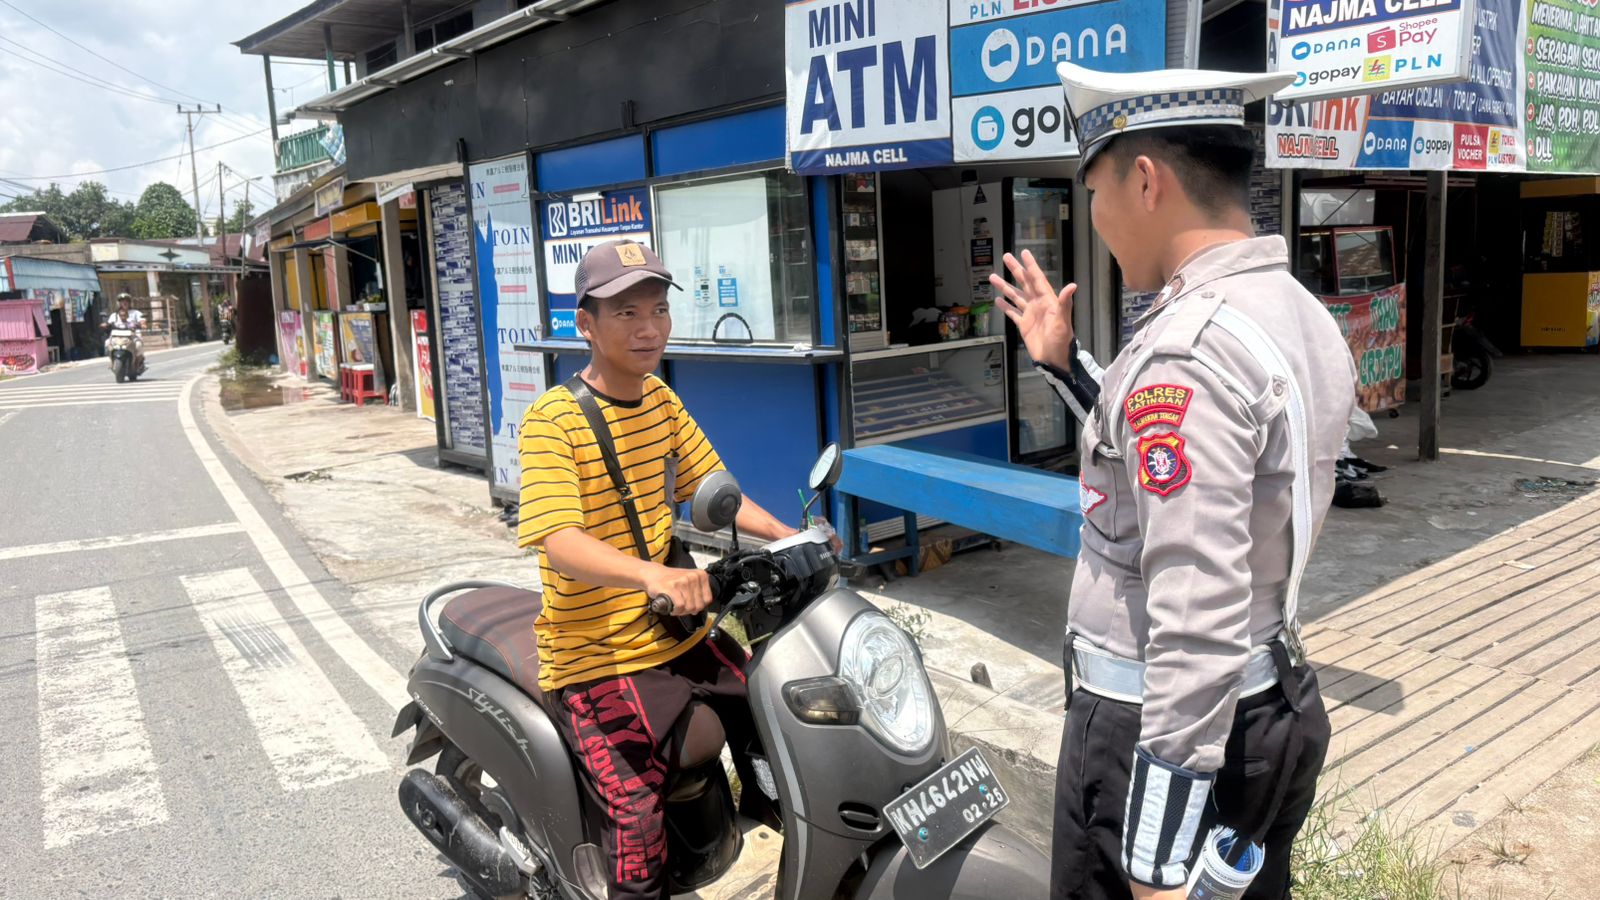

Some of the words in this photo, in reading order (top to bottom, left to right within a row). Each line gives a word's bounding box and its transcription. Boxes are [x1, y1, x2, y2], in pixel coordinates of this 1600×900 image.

[970, 2, 1001, 20] PLN
[1289, 0, 1378, 31] NAJMA
[1532, 3, 1573, 33] MENERIMA
[808, 0, 876, 48] MINI
[1399, 18, 1438, 32] Shopee
[1027, 23, 1127, 66] DANA
[1314, 37, 1361, 54] DANA
[1399, 28, 1438, 48] Pay
[1536, 37, 1579, 67] SERAGAM
[1395, 54, 1442, 73] PLN
[800, 35, 938, 135] ATM
[1309, 65, 1362, 87] gopay
[1537, 72, 1578, 99] PAKAIAN
[1382, 88, 1414, 105] BAYAR
[1414, 87, 1443, 108] CICILAN
[1536, 105, 1556, 132] JAS,
[1558, 108, 1581, 135] PDH,
[1377, 137, 1408, 151] DANA
[1426, 139, 1452, 153] gopay
[1461, 134, 1481, 146] PULSA
[1536, 137, 1553, 162] DLL
[825, 150, 870, 168] NAJMA
[873, 147, 908, 165] CELL
[1458, 149, 1483, 161] VOCHER
[568, 194, 644, 228] BRILink
[493, 226, 531, 247] TOIN
[552, 243, 582, 265] MINI
[559, 320, 575, 328] DANA
[497, 327, 537, 345] TOIN
[1359, 344, 1403, 386] CRISPY
[1127, 387, 1187, 409] POLRES
[467, 687, 529, 750] Stylish
